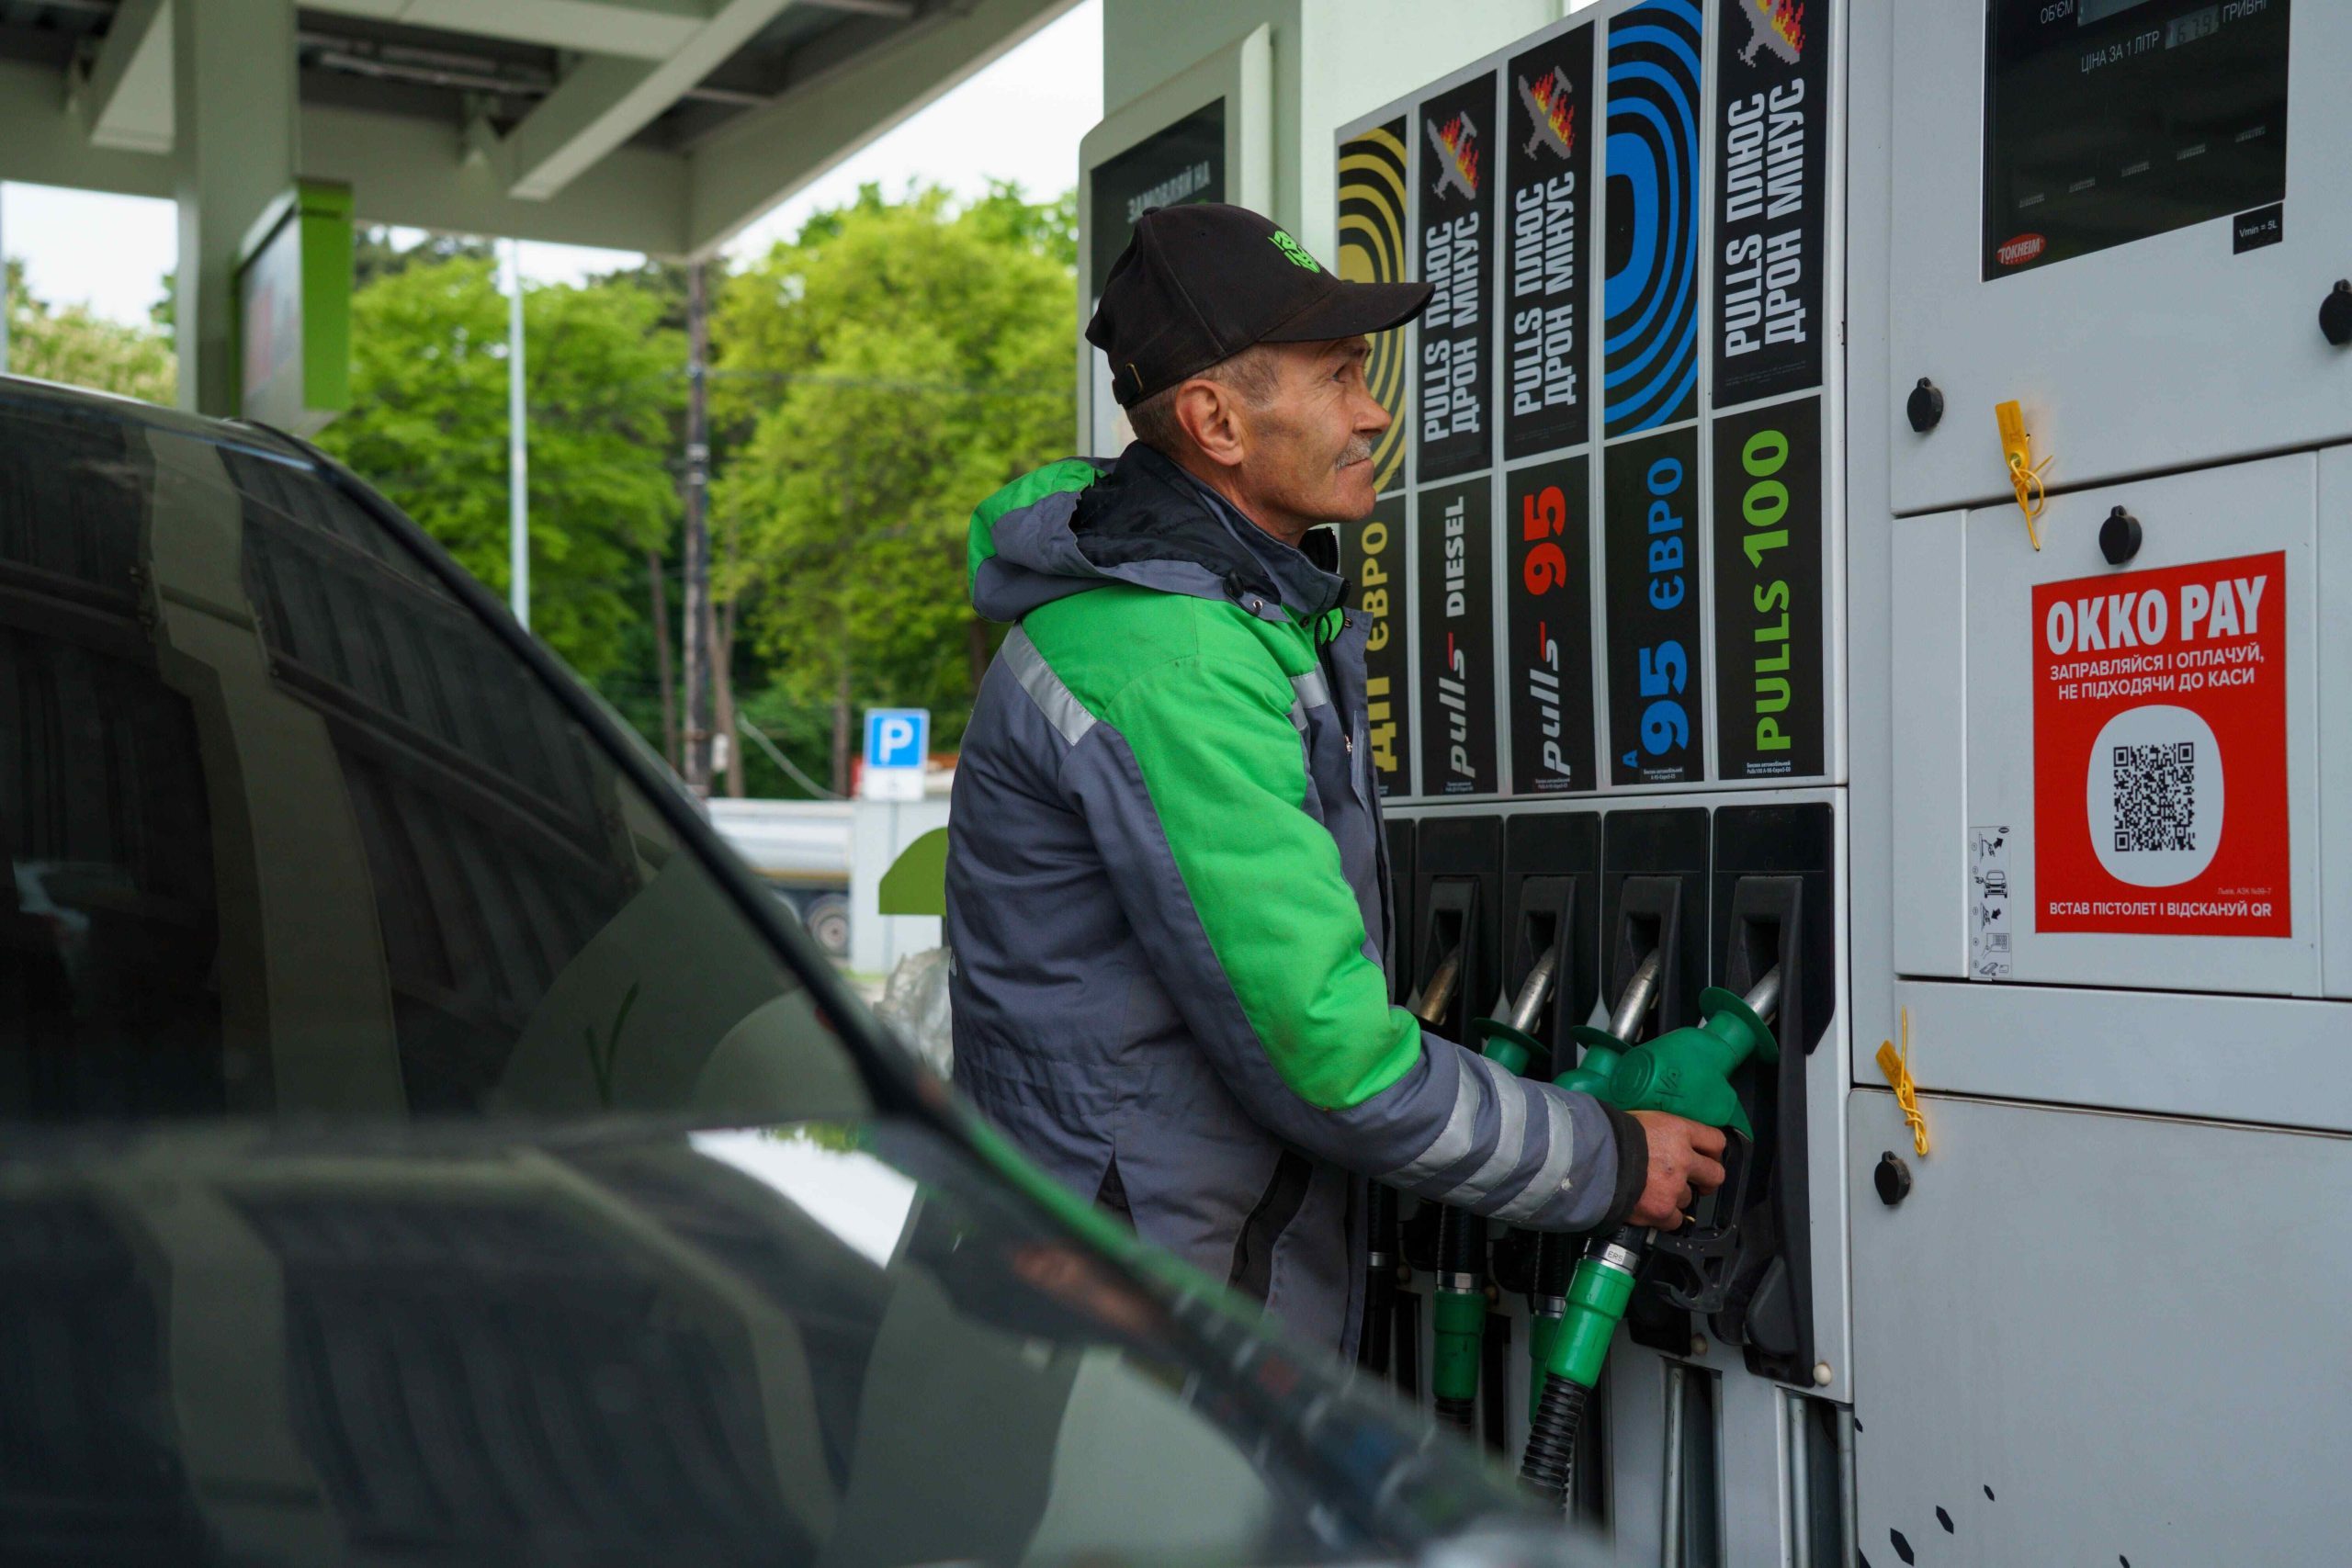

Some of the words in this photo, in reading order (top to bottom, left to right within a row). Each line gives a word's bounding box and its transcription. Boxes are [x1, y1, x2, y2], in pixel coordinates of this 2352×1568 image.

[2041, 0, 2074, 24] ОБ'ЄМ
[2081, 50, 2107, 74] ЦІНА
[2109, 45, 2123, 62] ЗА
[2127, 40, 2132, 55] 1
[2134, 30, 2160, 54] ЛІТР
[1726, 92, 1765, 223] ПЛЮС
[1767, 77, 1805, 220] МІНУС
[1453, 211, 1480, 329] МІНУС
[1515, 183, 1544, 297] ПЛЮС
[1545, 171, 1575, 296] МІНУС
[1996, 237, 2041, 264] TOKHEIM
[2239, 225, 2259, 238] Vmin
[2267, 220, 2278, 230] 5L
[1724, 232, 1763, 358] PULLS
[1764, 228, 1806, 345] ДРОН
[1424, 339, 1451, 443] PULLS
[1452, 336, 1480, 434] ДРОН
[1513, 306, 1544, 417] PULLS
[1544, 303, 1577, 406] ДРОН
[1523, 485, 1567, 596] 95
[1646, 457, 1685, 611] ЄВРО
[1742, 429, 1790, 570] 100
[1445, 495, 1465, 618] DIESEL
[1753, 580, 1792, 751] PULLS
[2046, 589, 2168, 655] OKKO
[2180, 575, 2267, 641] PAY
[2050, 653, 2164, 681] ЗАПРАВЛЯЙСЯ
[2167, 654, 2172, 670] І
[2177, 641, 2265, 669] ОПЛАЧУЙ,
[1439, 631, 1476, 779] pulls
[1529, 621, 1571, 776] pulls
[1639, 639, 1690, 756] 95
[2058, 684, 2078, 700] НЕ
[2081, 675, 2175, 699] ПІДХОДЯЧИ
[2178, 672, 2204, 692] ДО
[2208, 667, 2255, 688] КАСИ
[879, 718, 913, 763] P
[2050, 902, 2090, 915] ВСТАВ
[2092, 901, 2157, 916] ПІСТОЛЕТ
[2159, 902, 2164, 915] І
[2166, 900, 2248, 918] ВІДСКАНУЙ
[2251, 902, 2272, 917] QR
[1608, 1250, 1623, 1262] ERS
